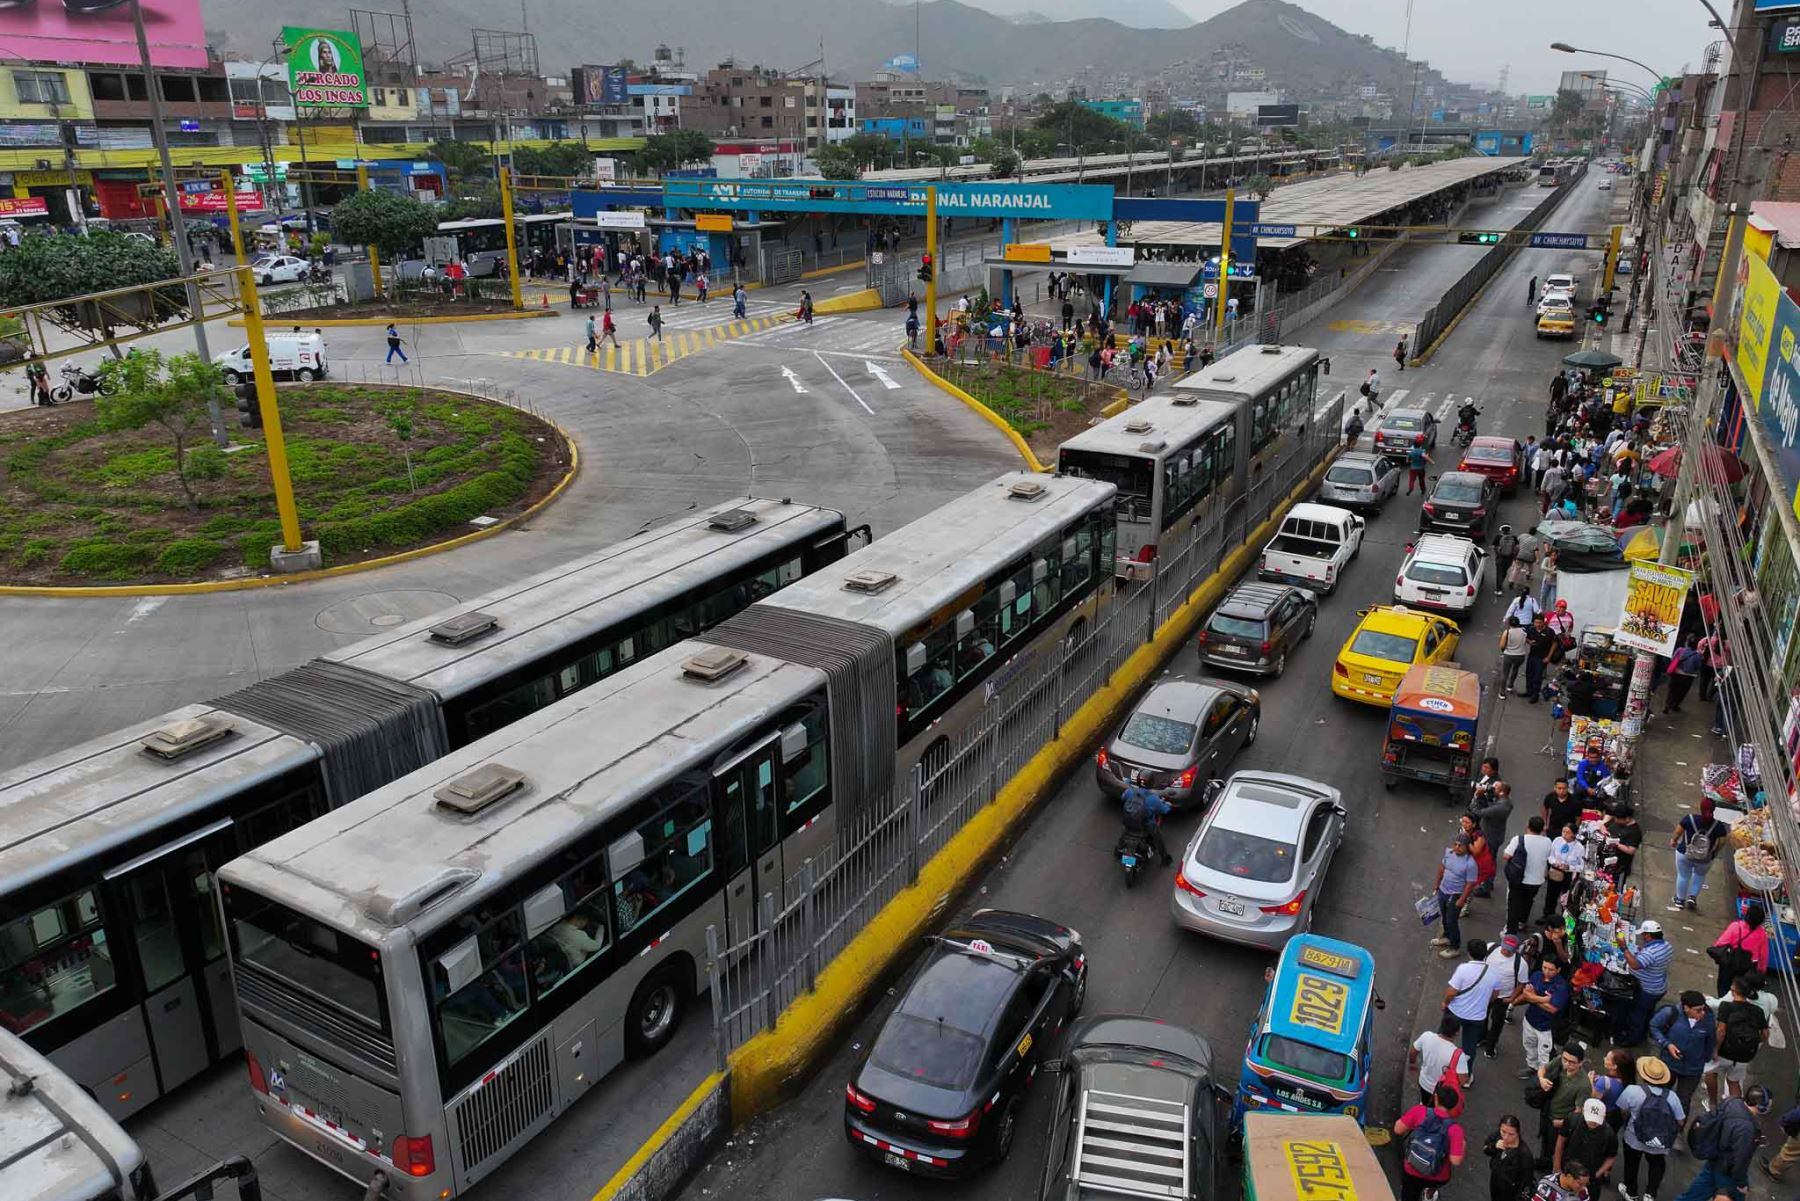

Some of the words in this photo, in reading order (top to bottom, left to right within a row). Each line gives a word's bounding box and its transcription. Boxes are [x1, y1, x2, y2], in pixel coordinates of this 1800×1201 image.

[296, 71, 359, 87] MERCADO
[298, 89, 322, 102] LOS
[325, 90, 363, 103] INCAS
[971, 193, 1052, 209] NARANJAL
[1543, 236, 1584, 247] CHINCHAYSUYO
[1769, 356, 1781, 411] de
[1775, 372, 1798, 448] Mayo
[1636, 580, 1679, 608] SAVIA
[1625, 594, 1681, 627] ANDINA
[972, 942, 988, 953] TAXI
[1296, 976, 1345, 1031] 1029
[1276, 1088, 1290, 1099] LOS
[1290, 1092, 1311, 1106] ANDES
